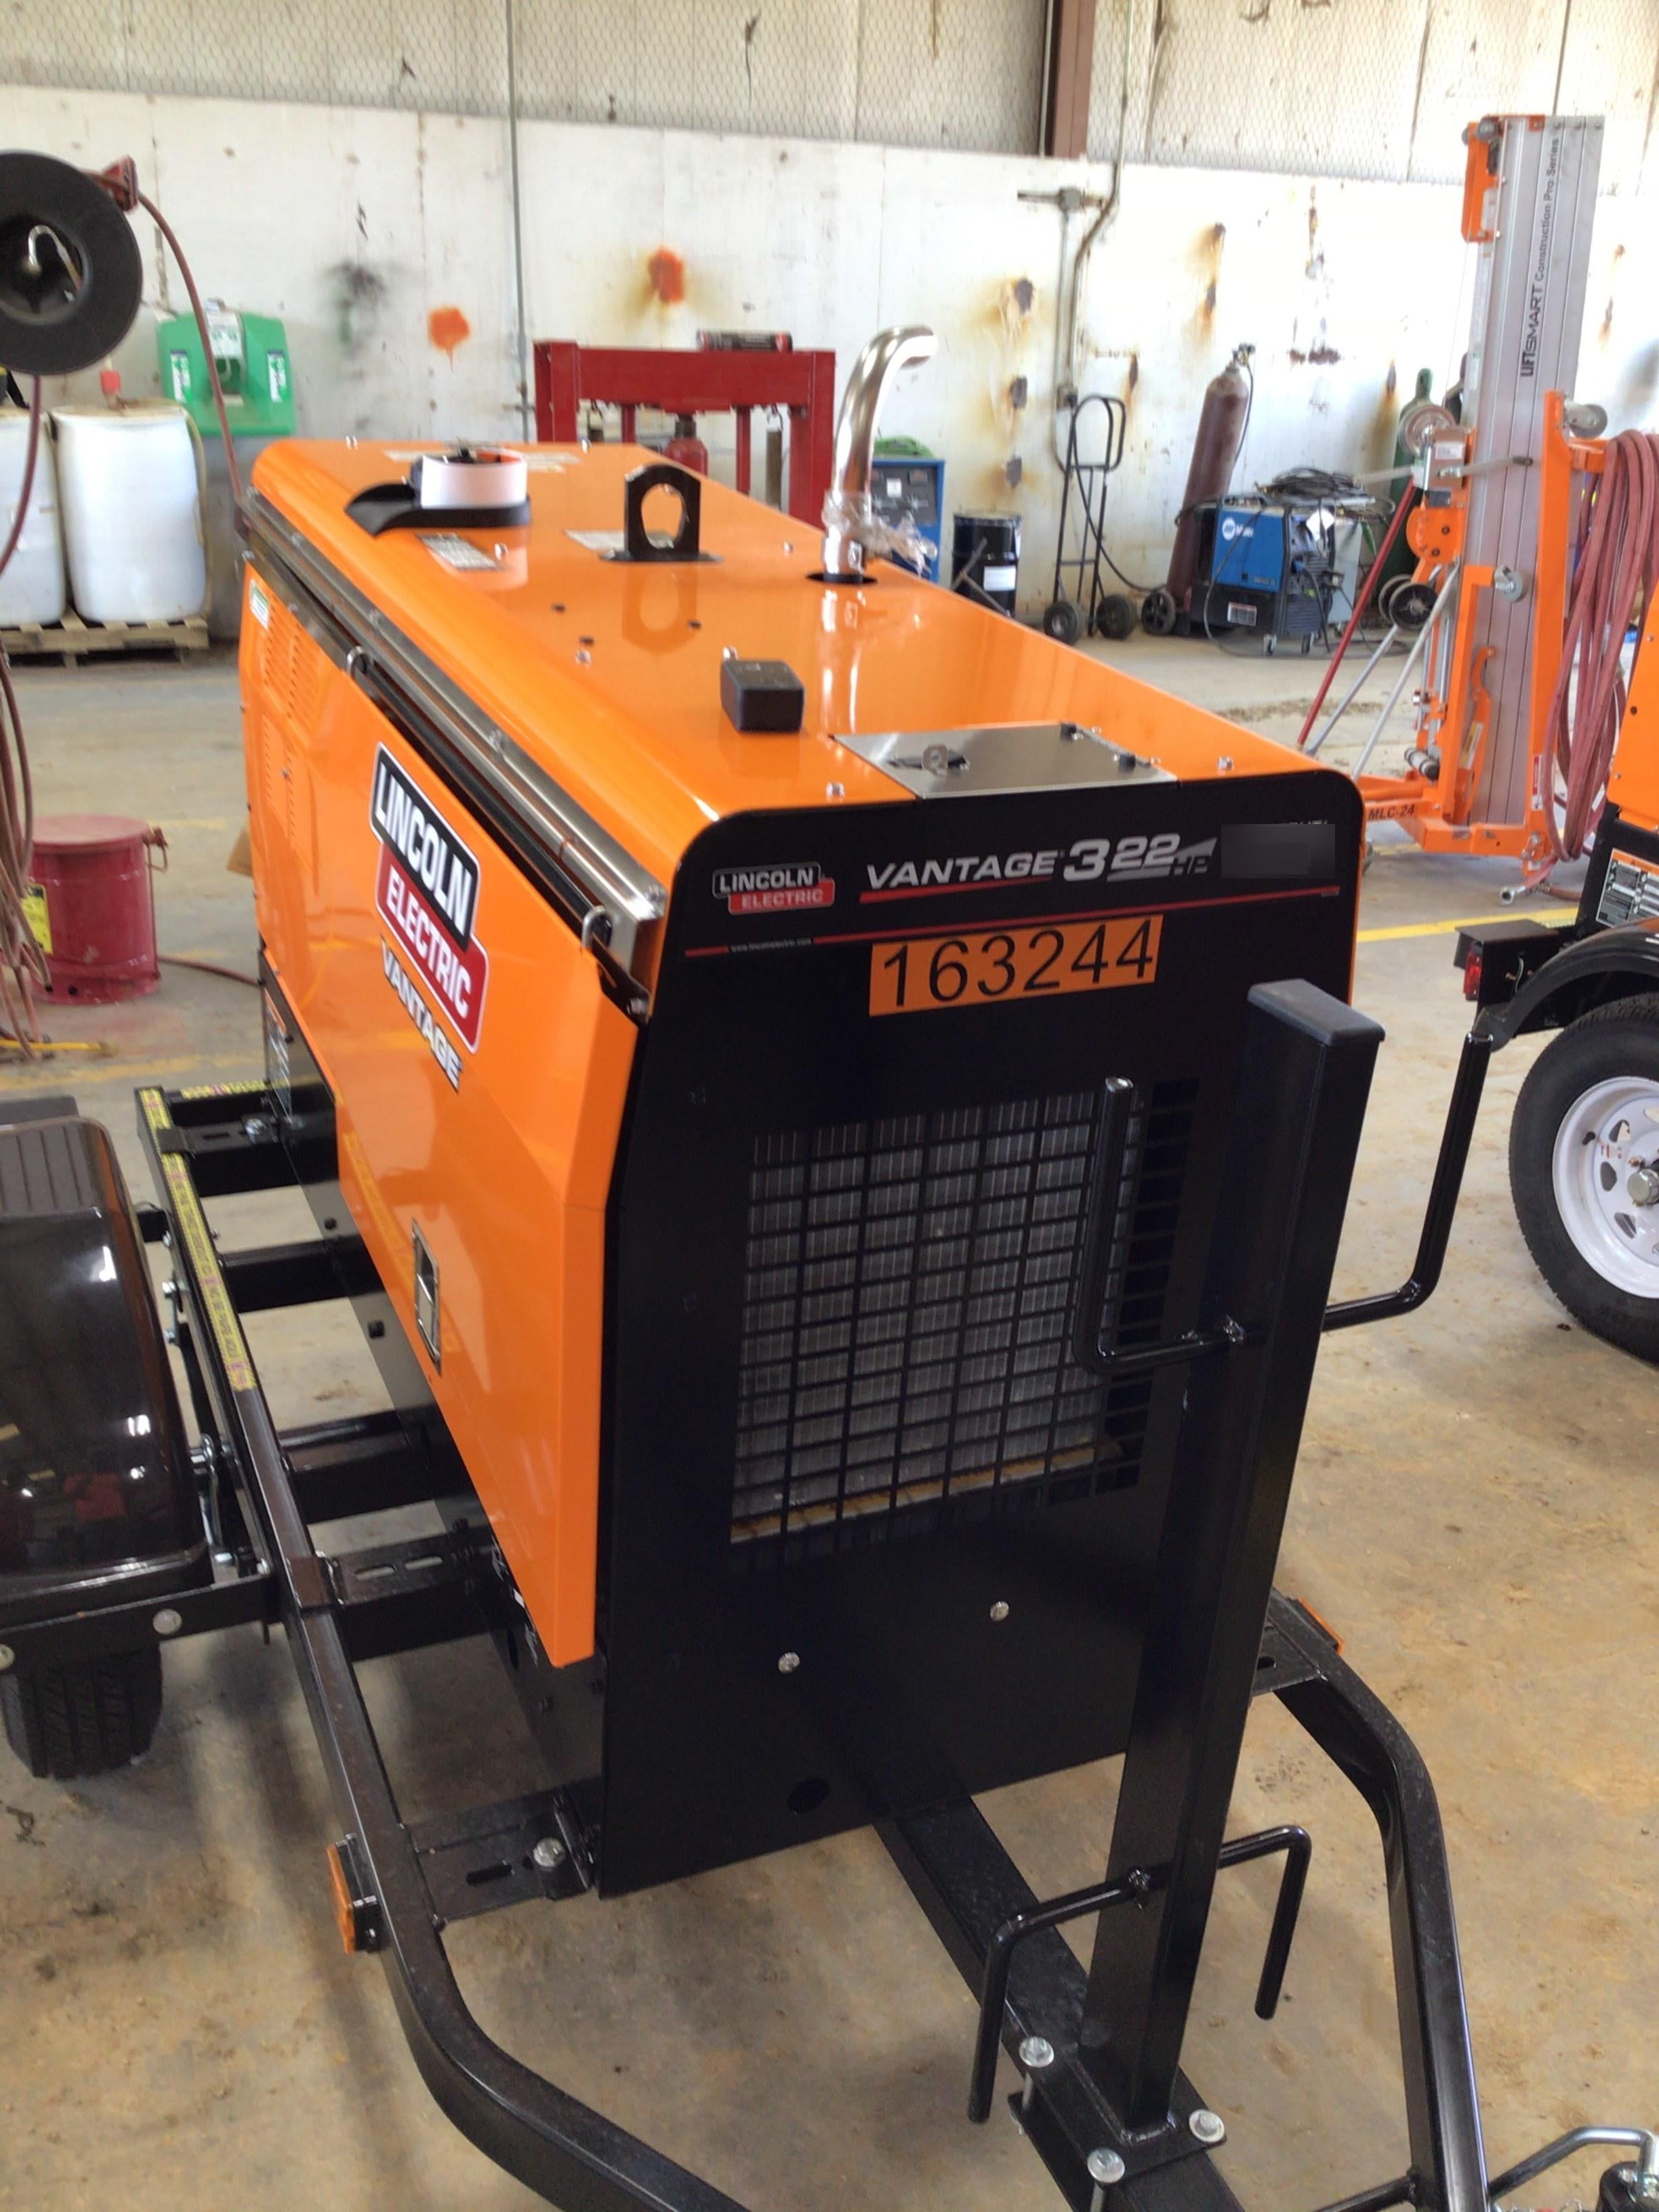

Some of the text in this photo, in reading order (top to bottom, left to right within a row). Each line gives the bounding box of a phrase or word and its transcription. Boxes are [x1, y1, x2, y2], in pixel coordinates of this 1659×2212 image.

[1520, 138, 1559, 377] LIFTSMART Construction Pro Series
[376, 760, 472, 936] LINCOLN
[1368, 804, 1416, 821] MLC-24
[719, 867, 814, 894] LINCOLN
[741, 888, 823, 909] ELECTRIC
[867, 849, 1059, 890] VANTAGE
[1063, 833, 1181, 881] 322
[386, 863, 472, 1019] ELECTRIC
[884, 920, 1153, 1007] 163244
[382, 934, 462, 1092] VANTAGE
